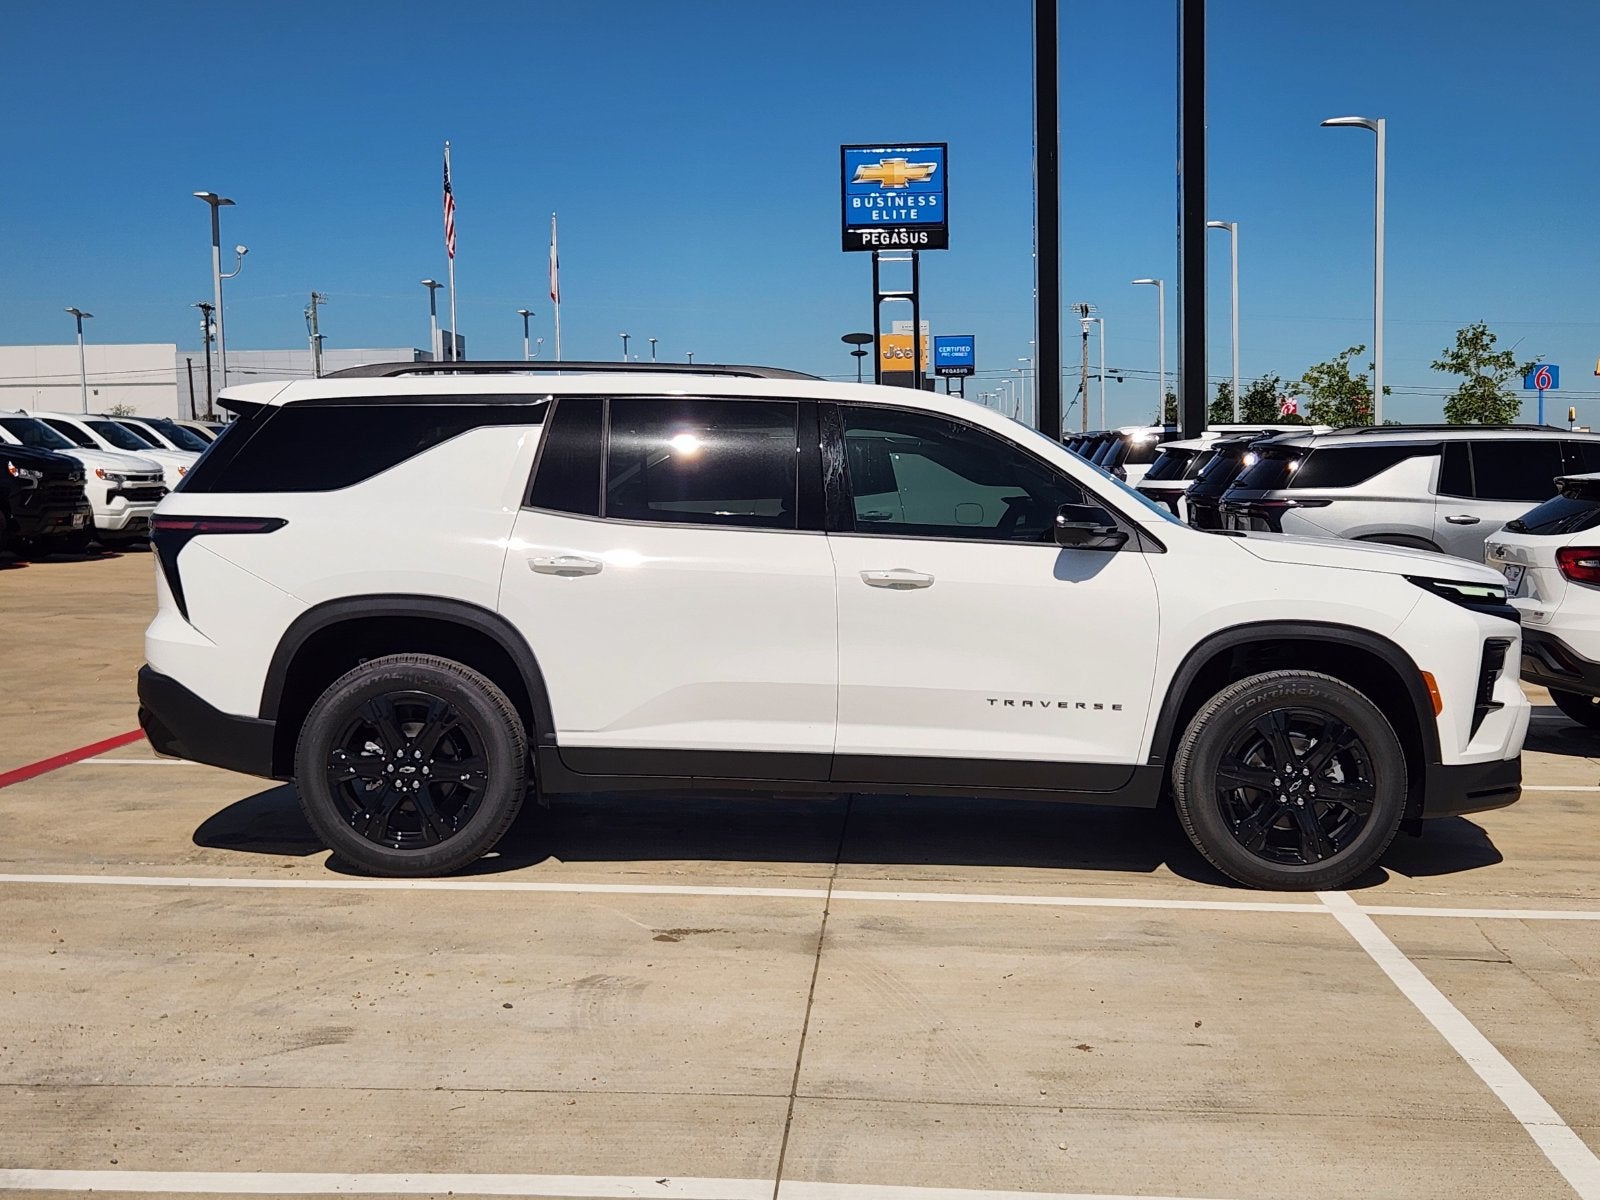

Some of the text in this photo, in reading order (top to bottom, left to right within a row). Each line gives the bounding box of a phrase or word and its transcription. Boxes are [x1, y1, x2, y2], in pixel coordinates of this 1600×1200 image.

[852, 196, 937, 208] BUSINESS
[871, 209, 918, 220] ELITE
[862, 232, 928, 245] PEGASUS
[1534, 365, 1552, 391] 6
[986, 698, 1123, 711] TRAVERSE
